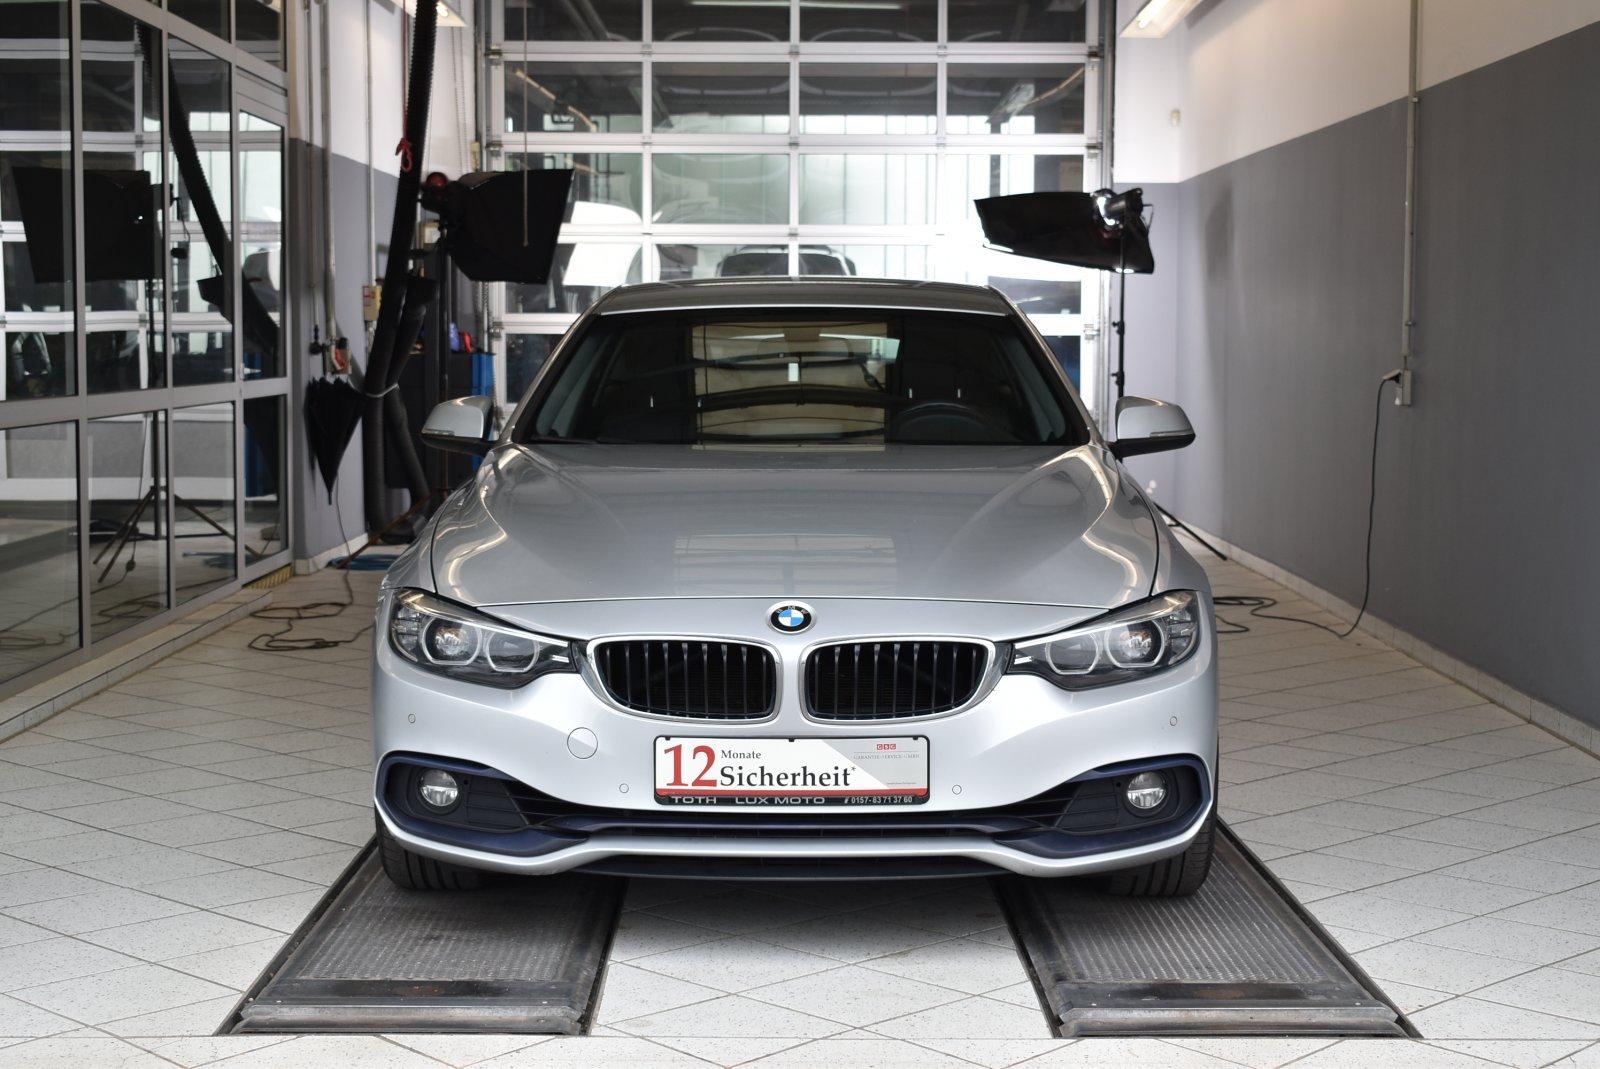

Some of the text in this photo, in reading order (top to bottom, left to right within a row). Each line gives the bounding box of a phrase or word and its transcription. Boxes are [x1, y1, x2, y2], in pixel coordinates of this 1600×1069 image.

[720, 749, 762, 759] Monate
[664, 744, 717, 787] 12
[671, 796, 826, 804] TOTH LUX MOTO
